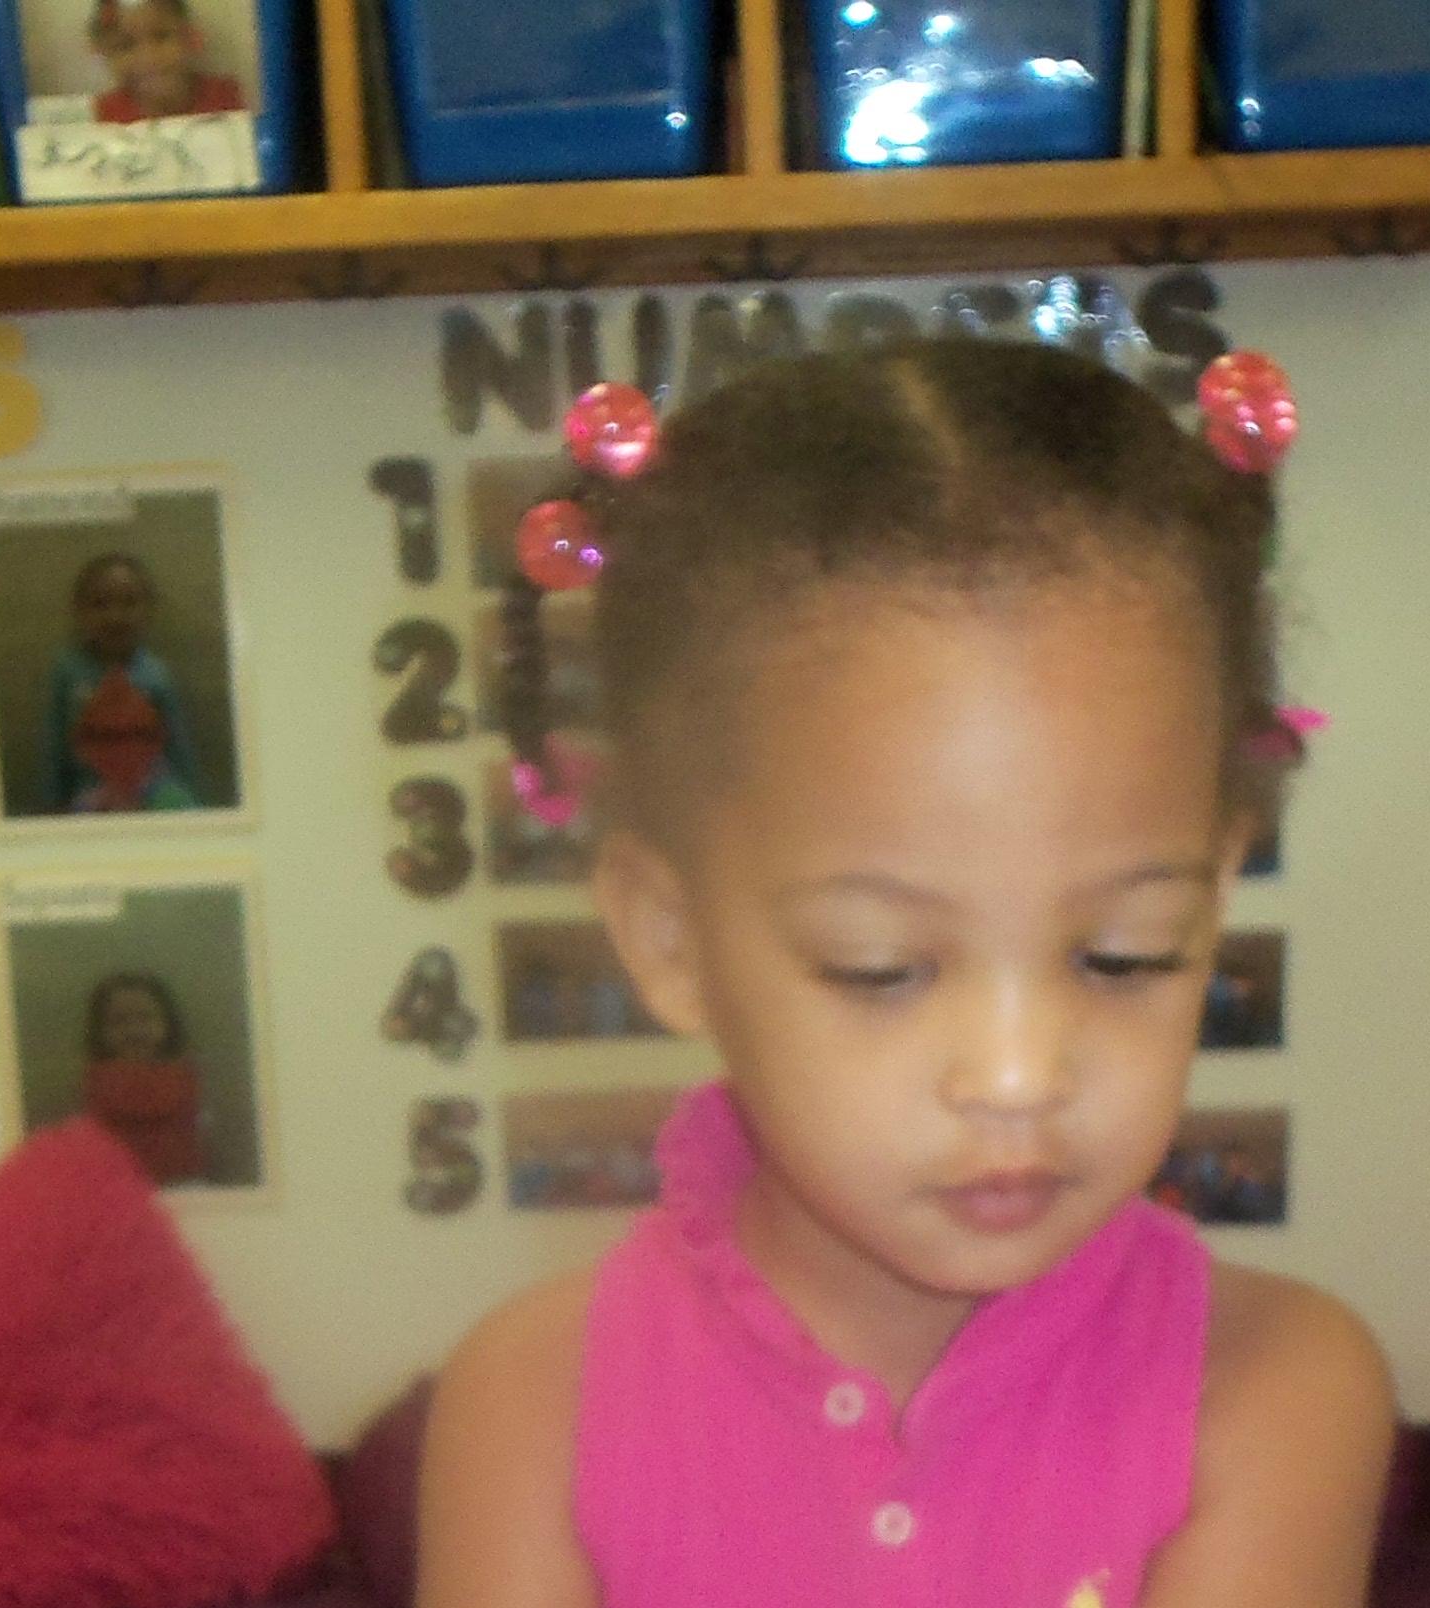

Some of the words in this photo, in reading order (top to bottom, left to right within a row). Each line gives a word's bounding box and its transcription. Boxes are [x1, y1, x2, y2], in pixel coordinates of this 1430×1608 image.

[367, 459, 441, 584] 1
[371, 617, 469, 744] 2
[387, 774, 477, 900] 3
[381, 945, 481, 1062] 4
[402, 1094, 485, 1217] 5
